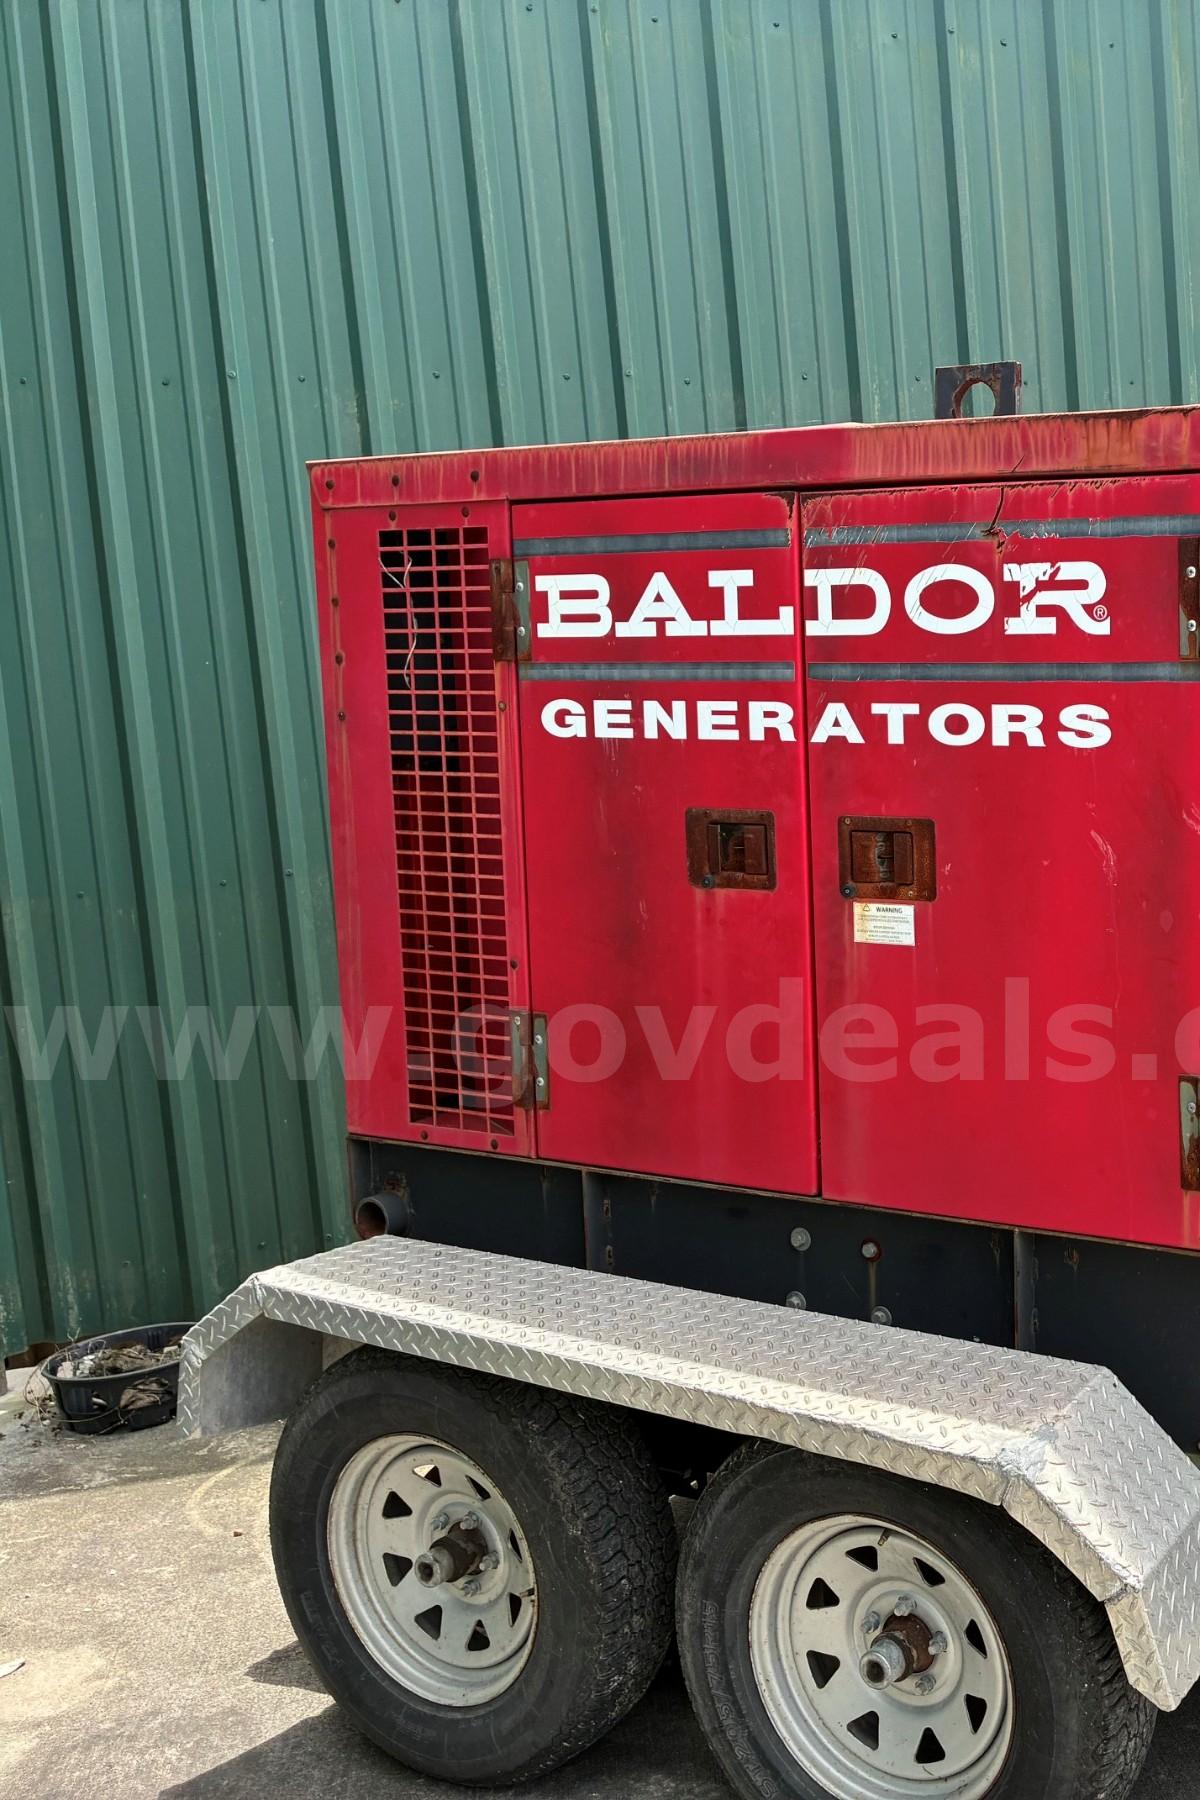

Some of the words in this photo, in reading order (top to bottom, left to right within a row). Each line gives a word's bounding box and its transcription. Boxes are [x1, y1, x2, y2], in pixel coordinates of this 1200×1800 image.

[534, 561, 1111, 638] BALDOR
[540, 698, 1112, 748] GENERATORS
[875, 906, 903, 914] WARNING
